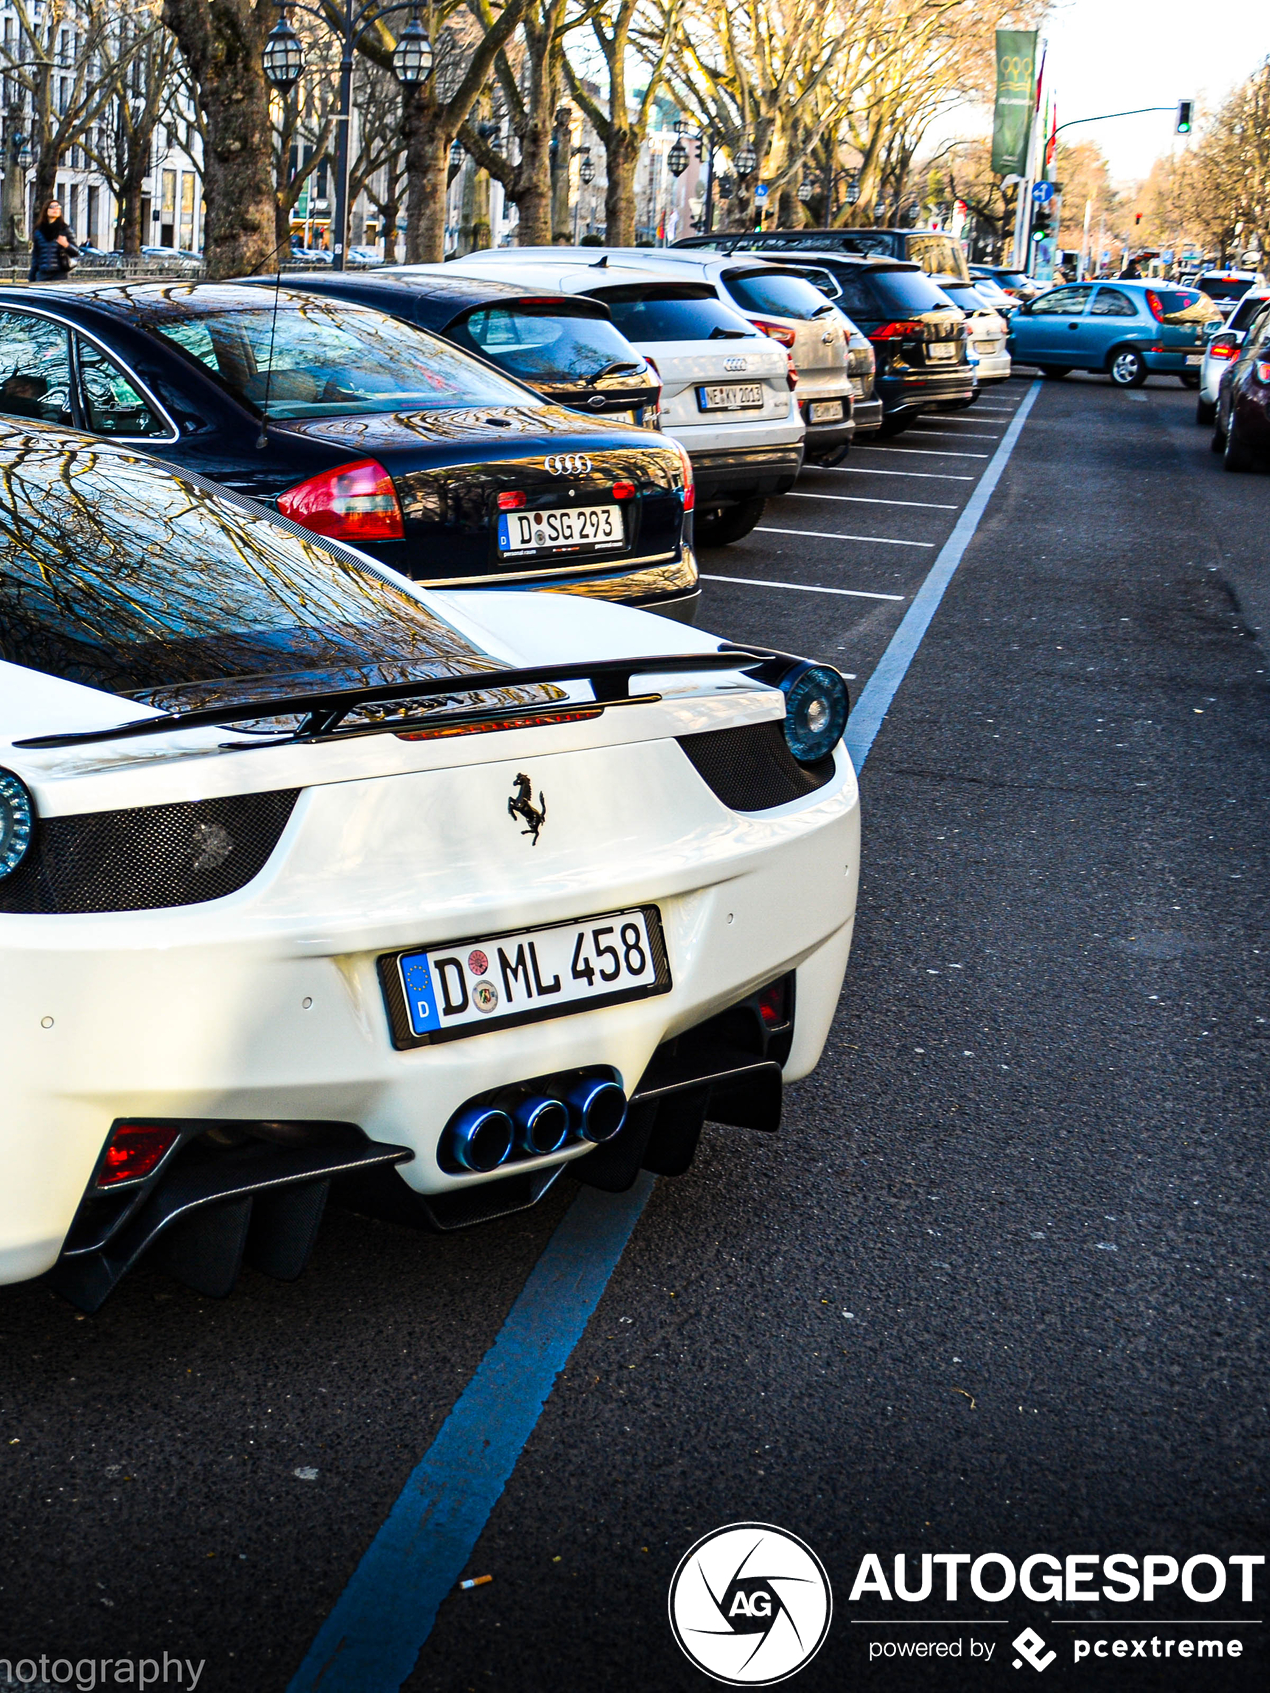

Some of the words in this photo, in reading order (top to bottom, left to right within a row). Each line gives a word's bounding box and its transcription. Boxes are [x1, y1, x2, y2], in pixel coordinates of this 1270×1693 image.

[739, 386, 761, 403] 2013
[517, 515, 532, 545] D
[546, 512, 574, 542] SG
[577, 509, 613, 539] 293
[500, 536, 507, 545] D
[434, 956, 469, 1016] D
[497, 941, 562, 1003] ML
[570, 922, 646, 986] 458
[418, 1000, 430, 1018] D
